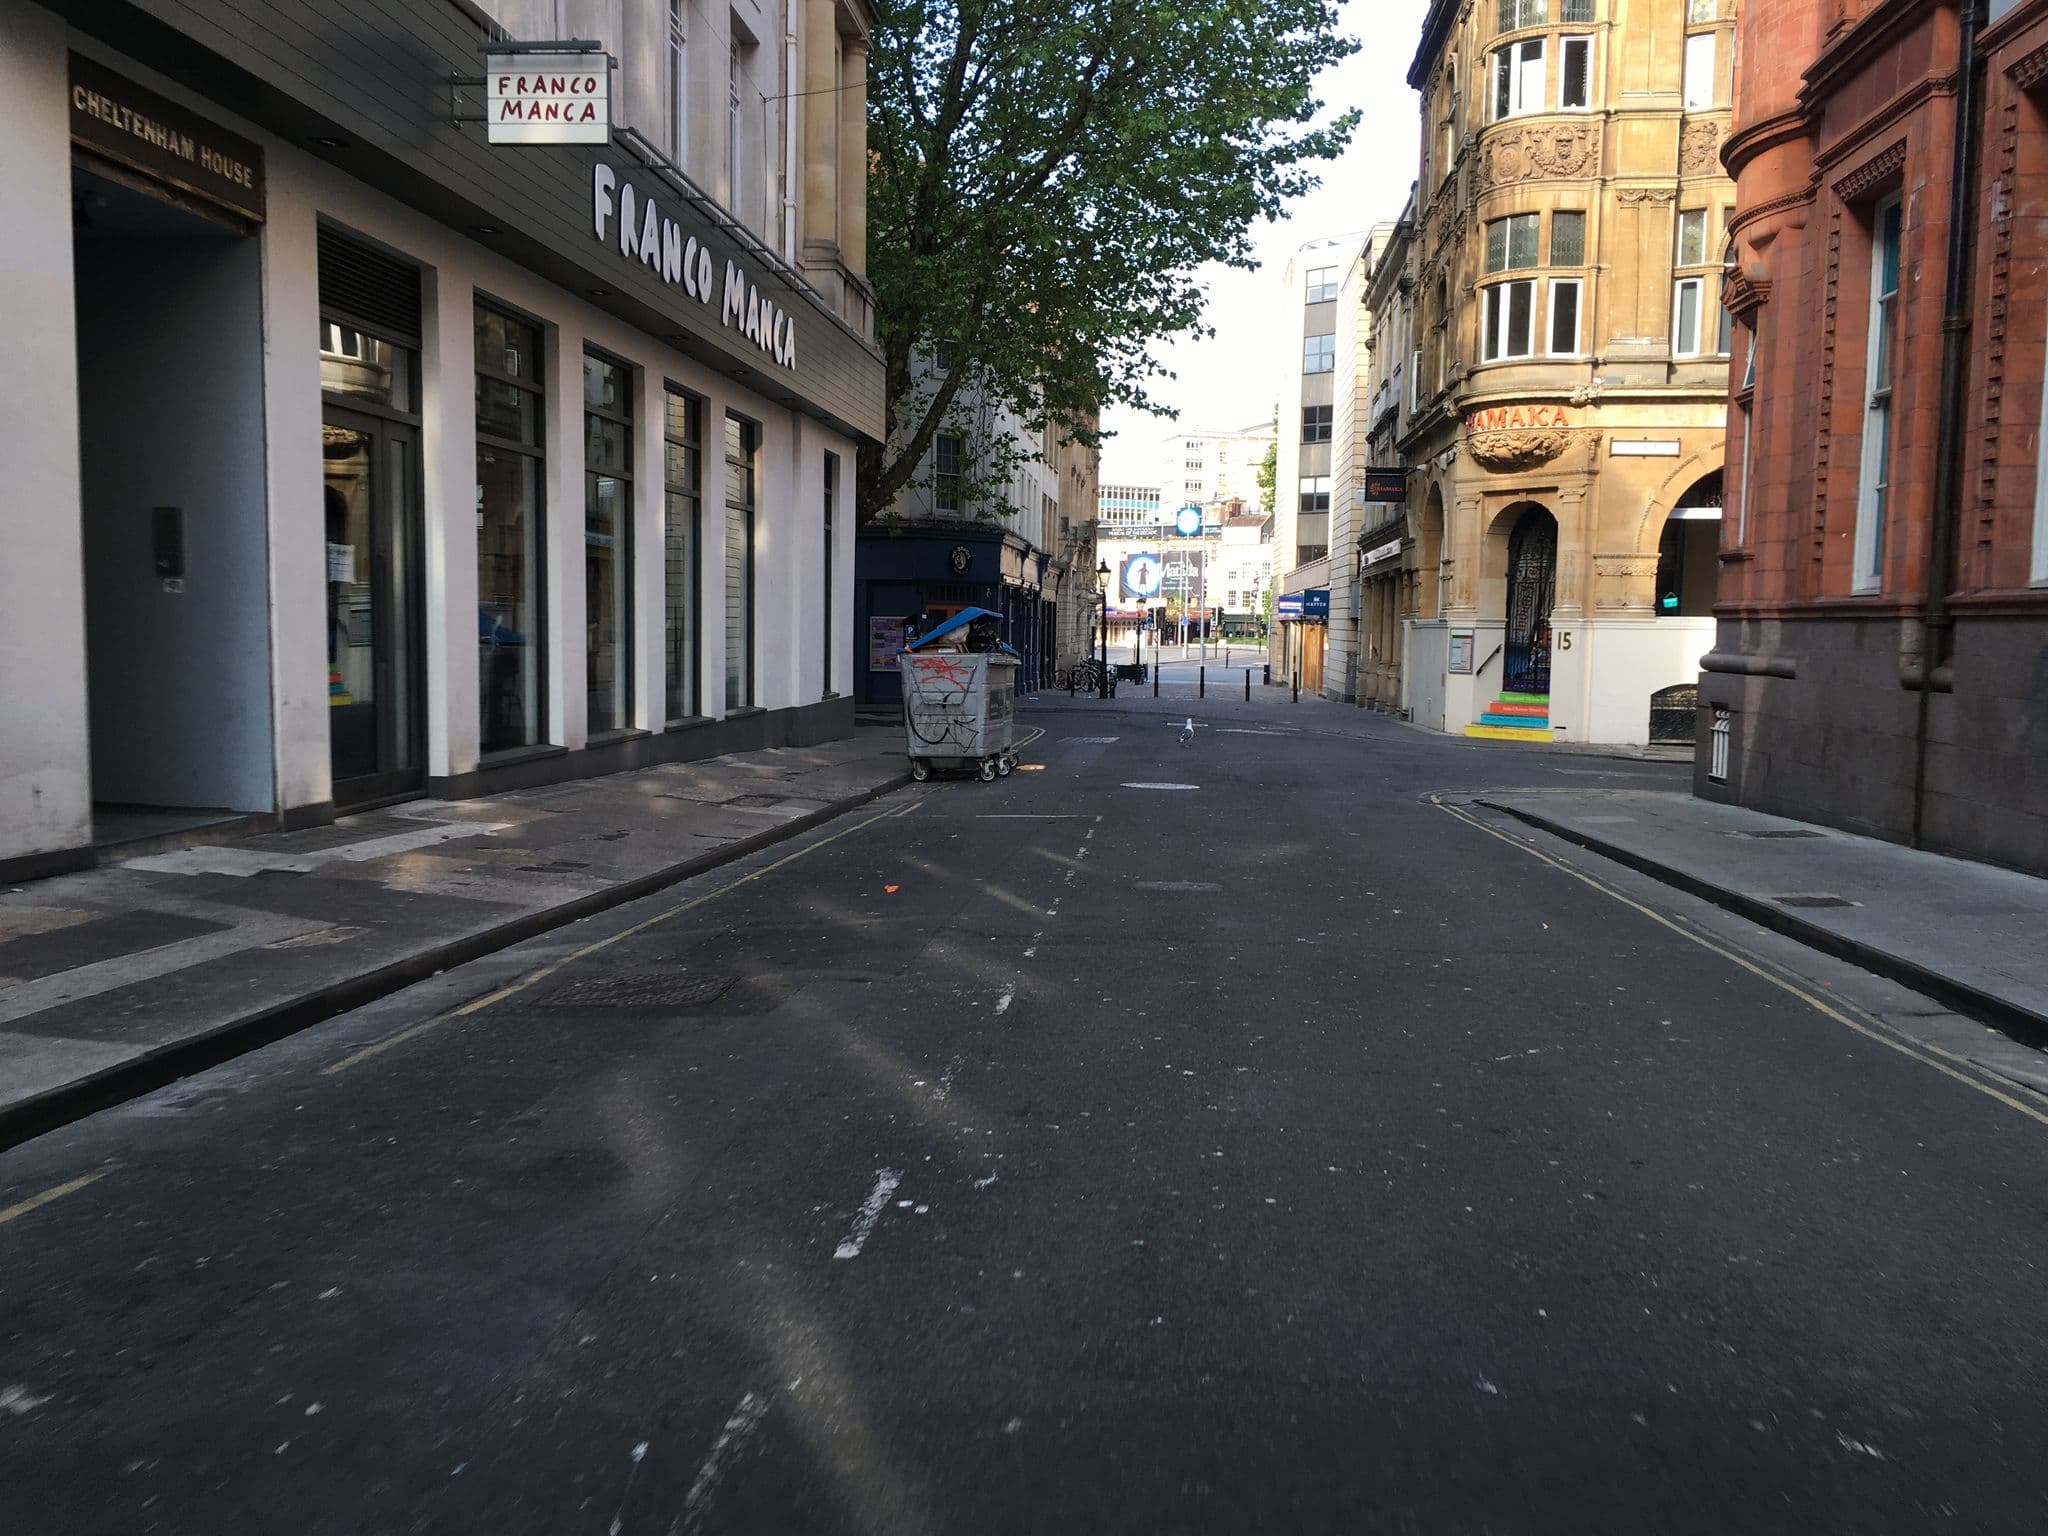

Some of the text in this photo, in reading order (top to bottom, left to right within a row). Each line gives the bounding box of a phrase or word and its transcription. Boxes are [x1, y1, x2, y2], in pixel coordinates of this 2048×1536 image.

[498, 74, 597, 95] FRANCO
[500, 99, 596, 122] MANCA
[73, 85, 253, 189] CHELTENHAM HOUSE
[594, 163, 796, 371] FRANCO MANCA
[1558, 631, 1572, 650] 15
